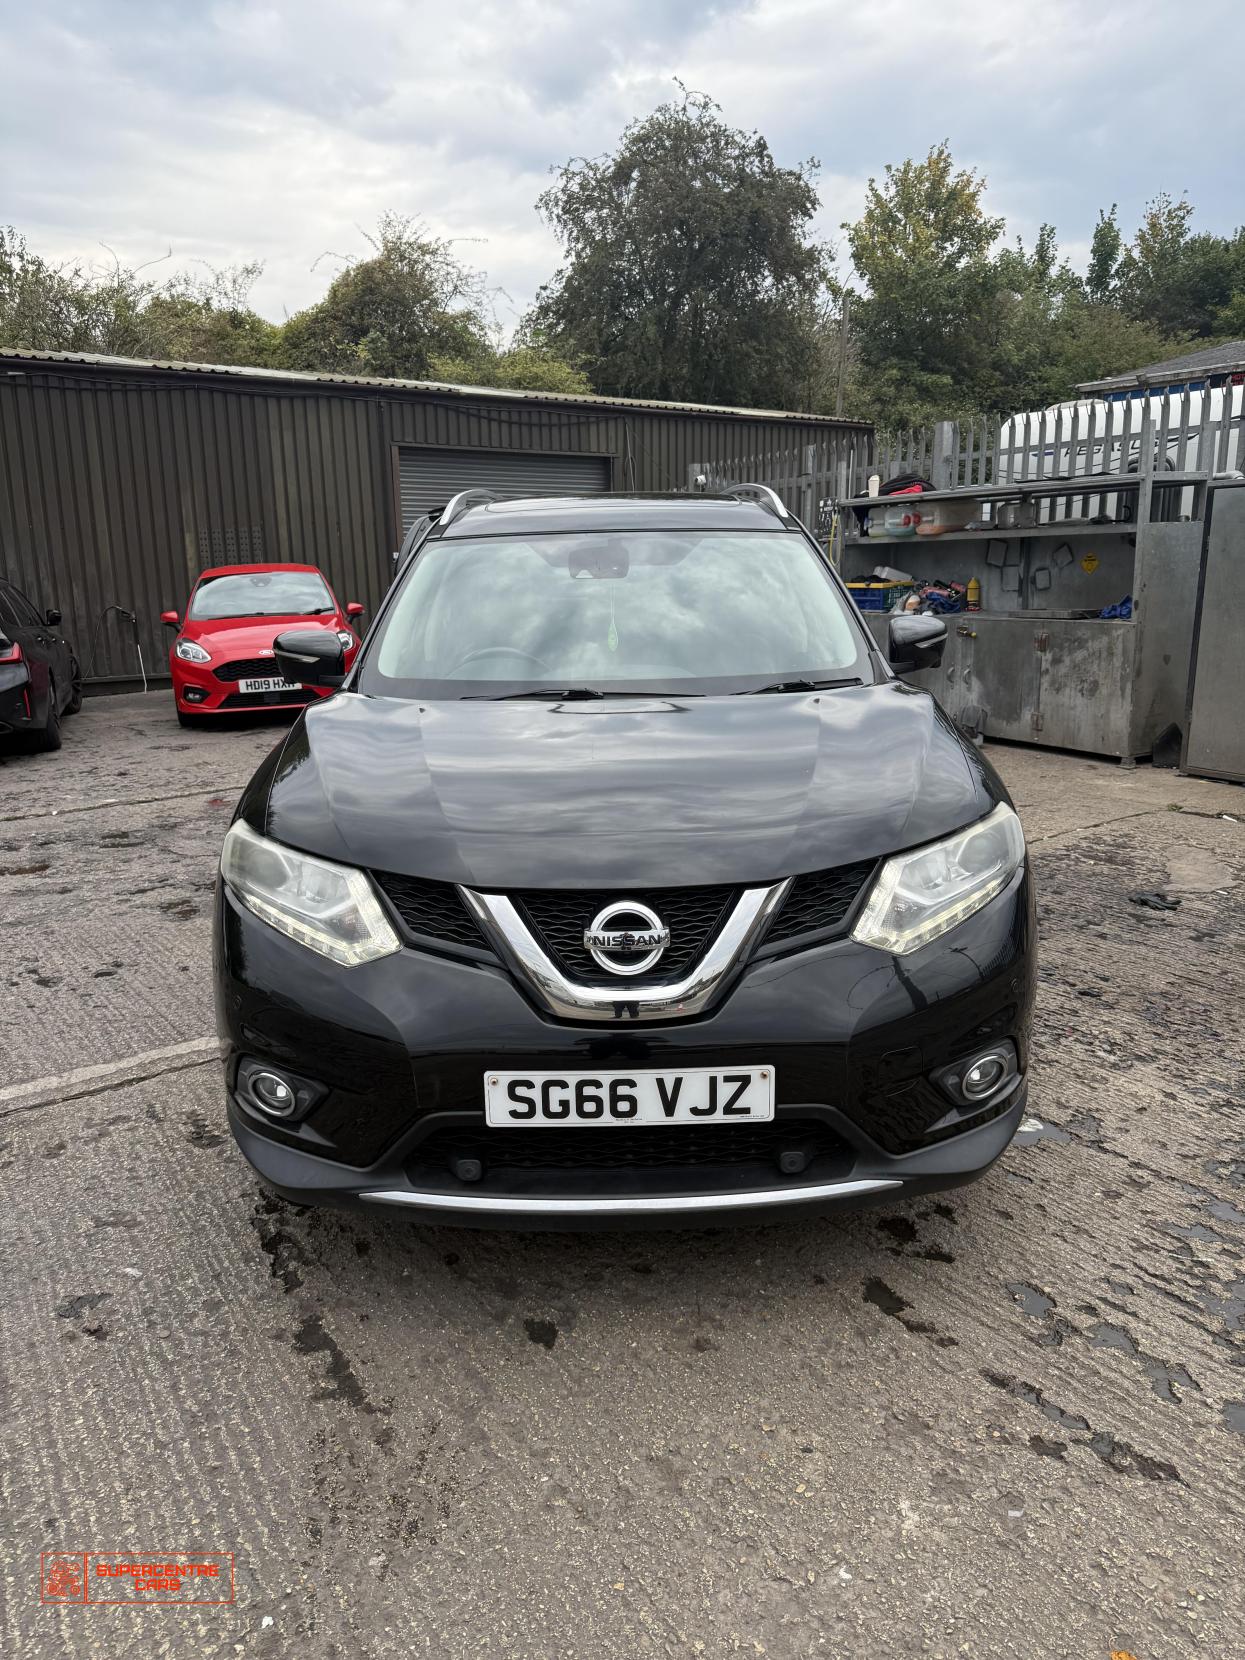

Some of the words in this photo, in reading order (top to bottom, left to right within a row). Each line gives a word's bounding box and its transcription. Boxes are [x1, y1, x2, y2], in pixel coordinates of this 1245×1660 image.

[245, 680, 271, 691] HD19
[593, 933, 661, 947] NISSAN
[507, 1078, 638, 1120] SG66
[655, 1074, 752, 1118] VJZ
